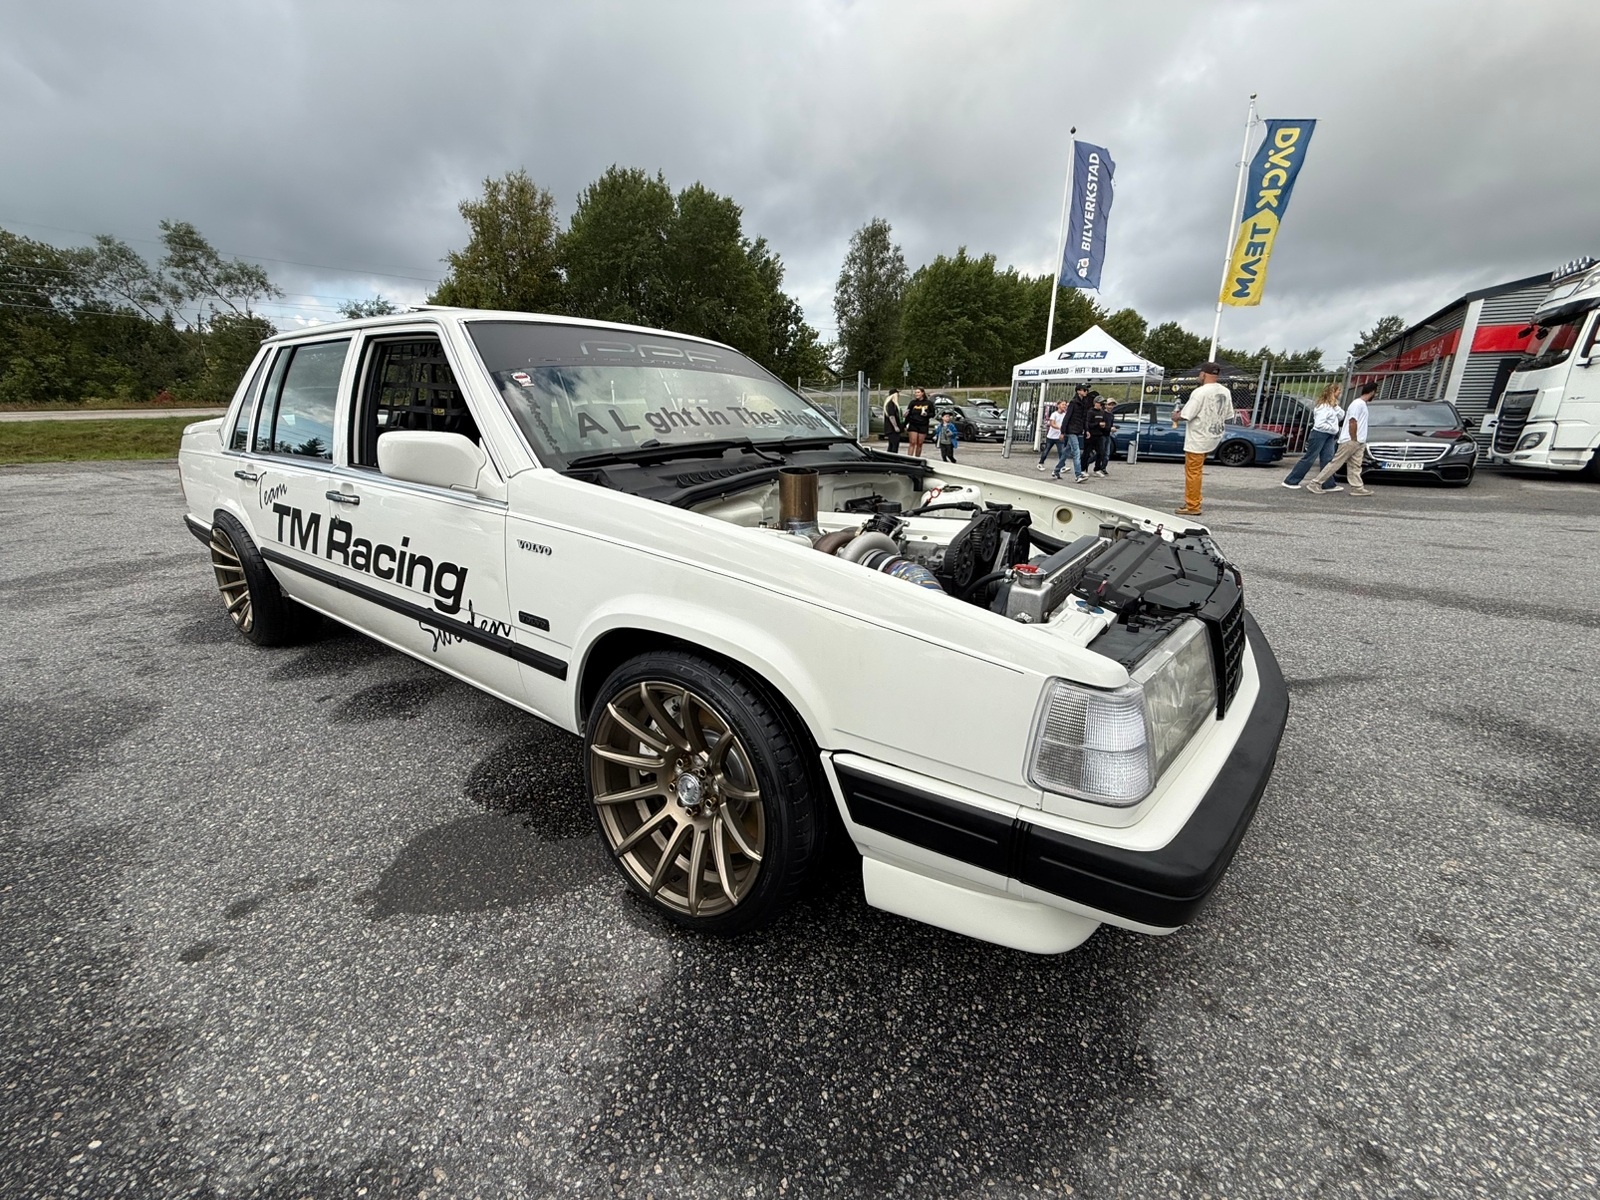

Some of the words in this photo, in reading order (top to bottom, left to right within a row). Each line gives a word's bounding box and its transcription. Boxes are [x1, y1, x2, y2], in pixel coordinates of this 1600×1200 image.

[1081, 152, 1100, 252] BILVERKSTAD
[577, 412, 609, 438] A
[696, 406, 730, 426] In
[726, 406, 778, 426] The
[773, 408, 830, 431] Night
[254, 470, 288, 509] Team
[272, 503, 321, 554] TM
[326, 516, 469, 614] Racing
[516, 539, 552, 556] VOLVO
